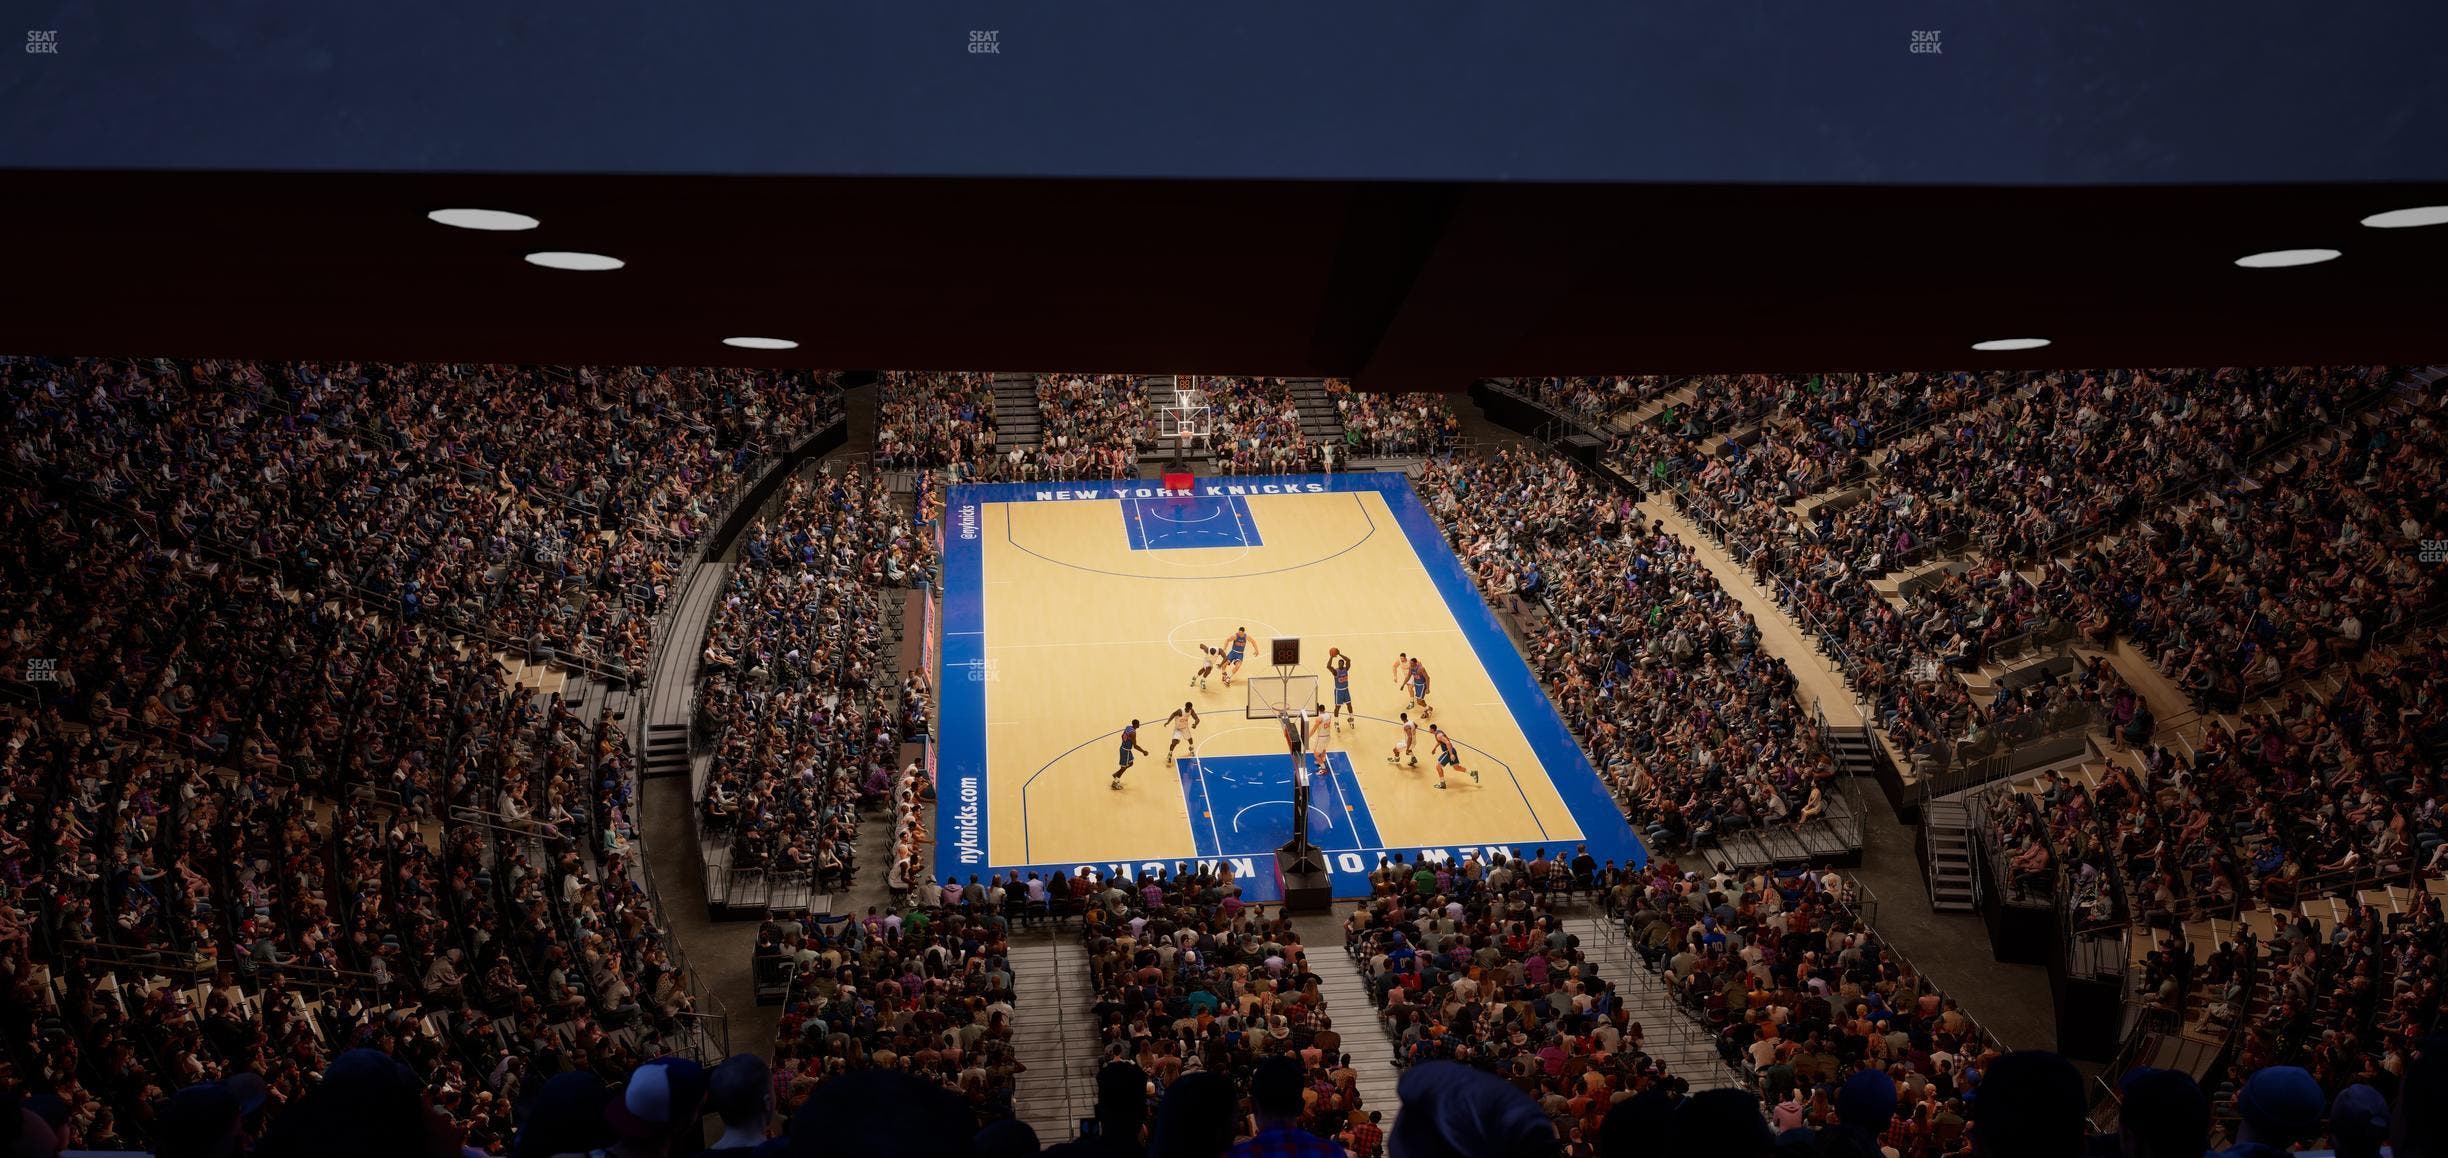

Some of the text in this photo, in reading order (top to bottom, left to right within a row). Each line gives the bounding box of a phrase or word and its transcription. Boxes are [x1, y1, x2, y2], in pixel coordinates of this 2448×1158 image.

[1036, 482, 1324, 501] NEW YORK KNICKS
[958, 505, 979, 539] @nyknicks
[953, 777, 984, 864] nyknicks.com
